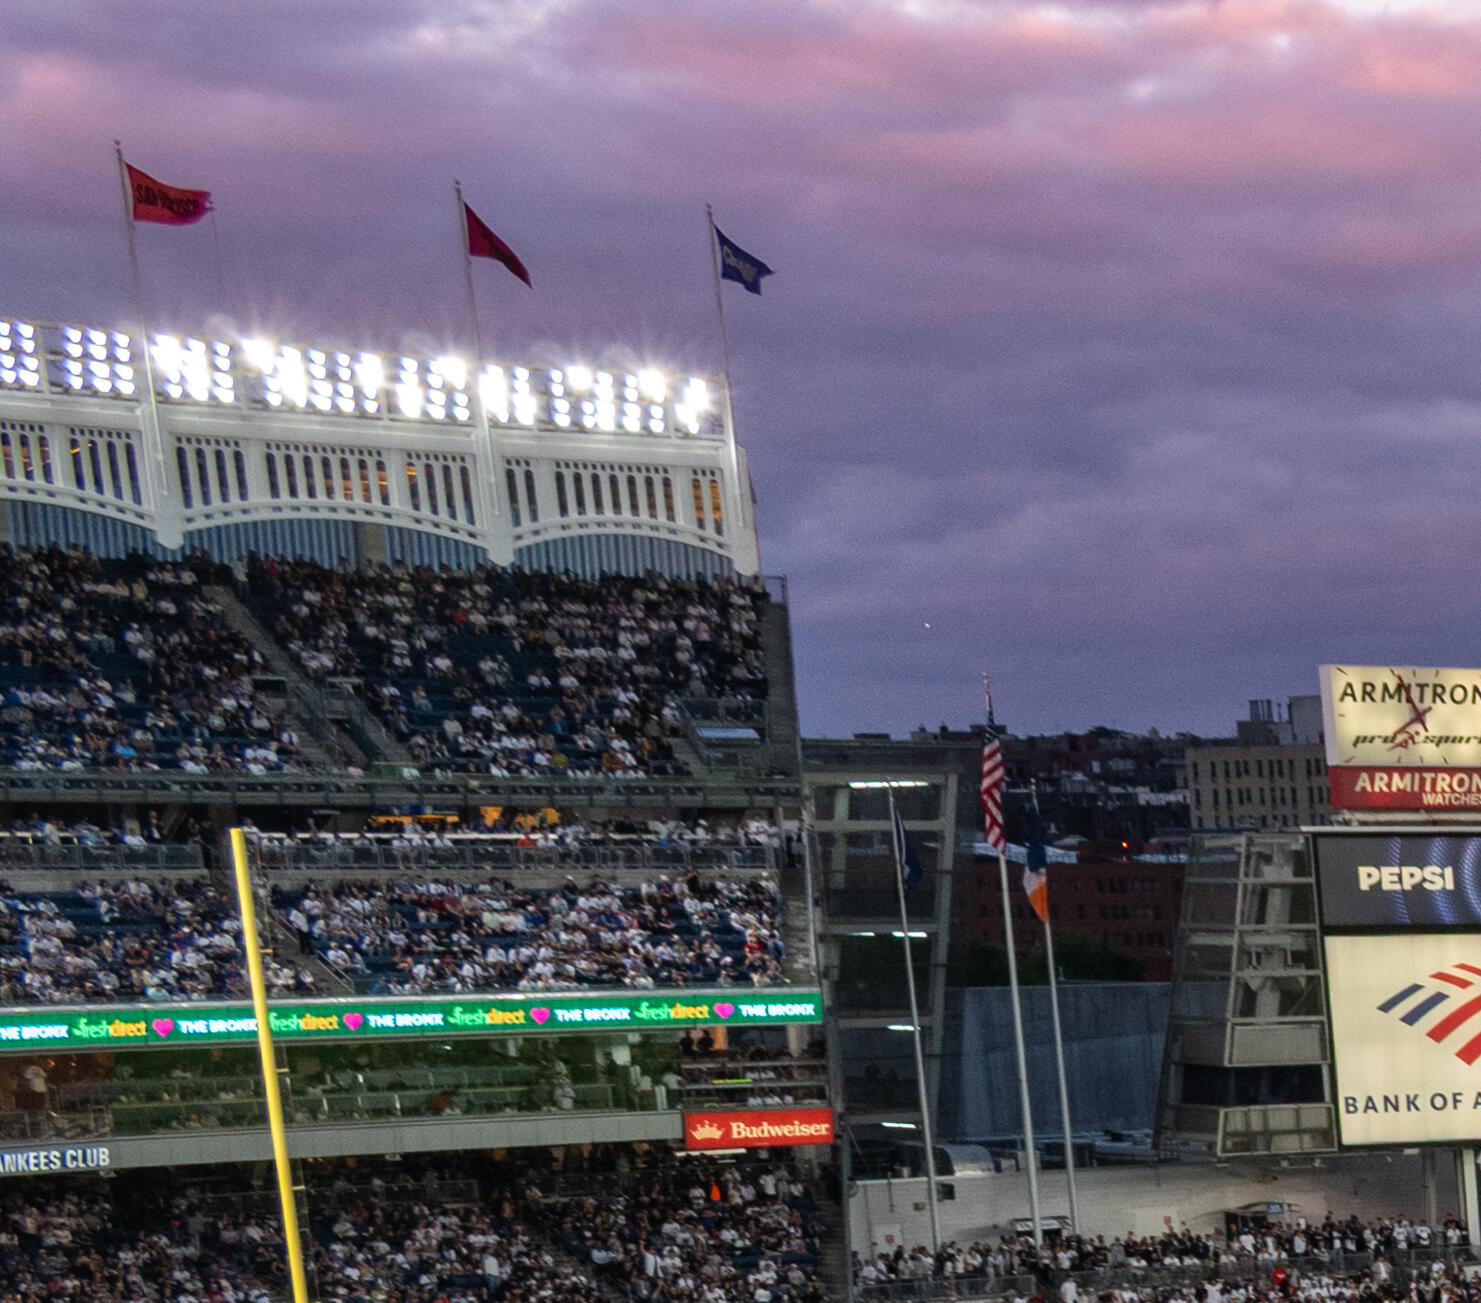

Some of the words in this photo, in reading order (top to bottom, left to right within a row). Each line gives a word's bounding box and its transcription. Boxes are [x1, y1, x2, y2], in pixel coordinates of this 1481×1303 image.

[1358, 864, 1454, 892] PEPSI
[585, 1007, 631, 1022] BRONX
[1344, 1094, 1422, 1116] BANK
[1430, 1092, 1466, 1112] OF
[730, 1120, 830, 1141] Budweiser
